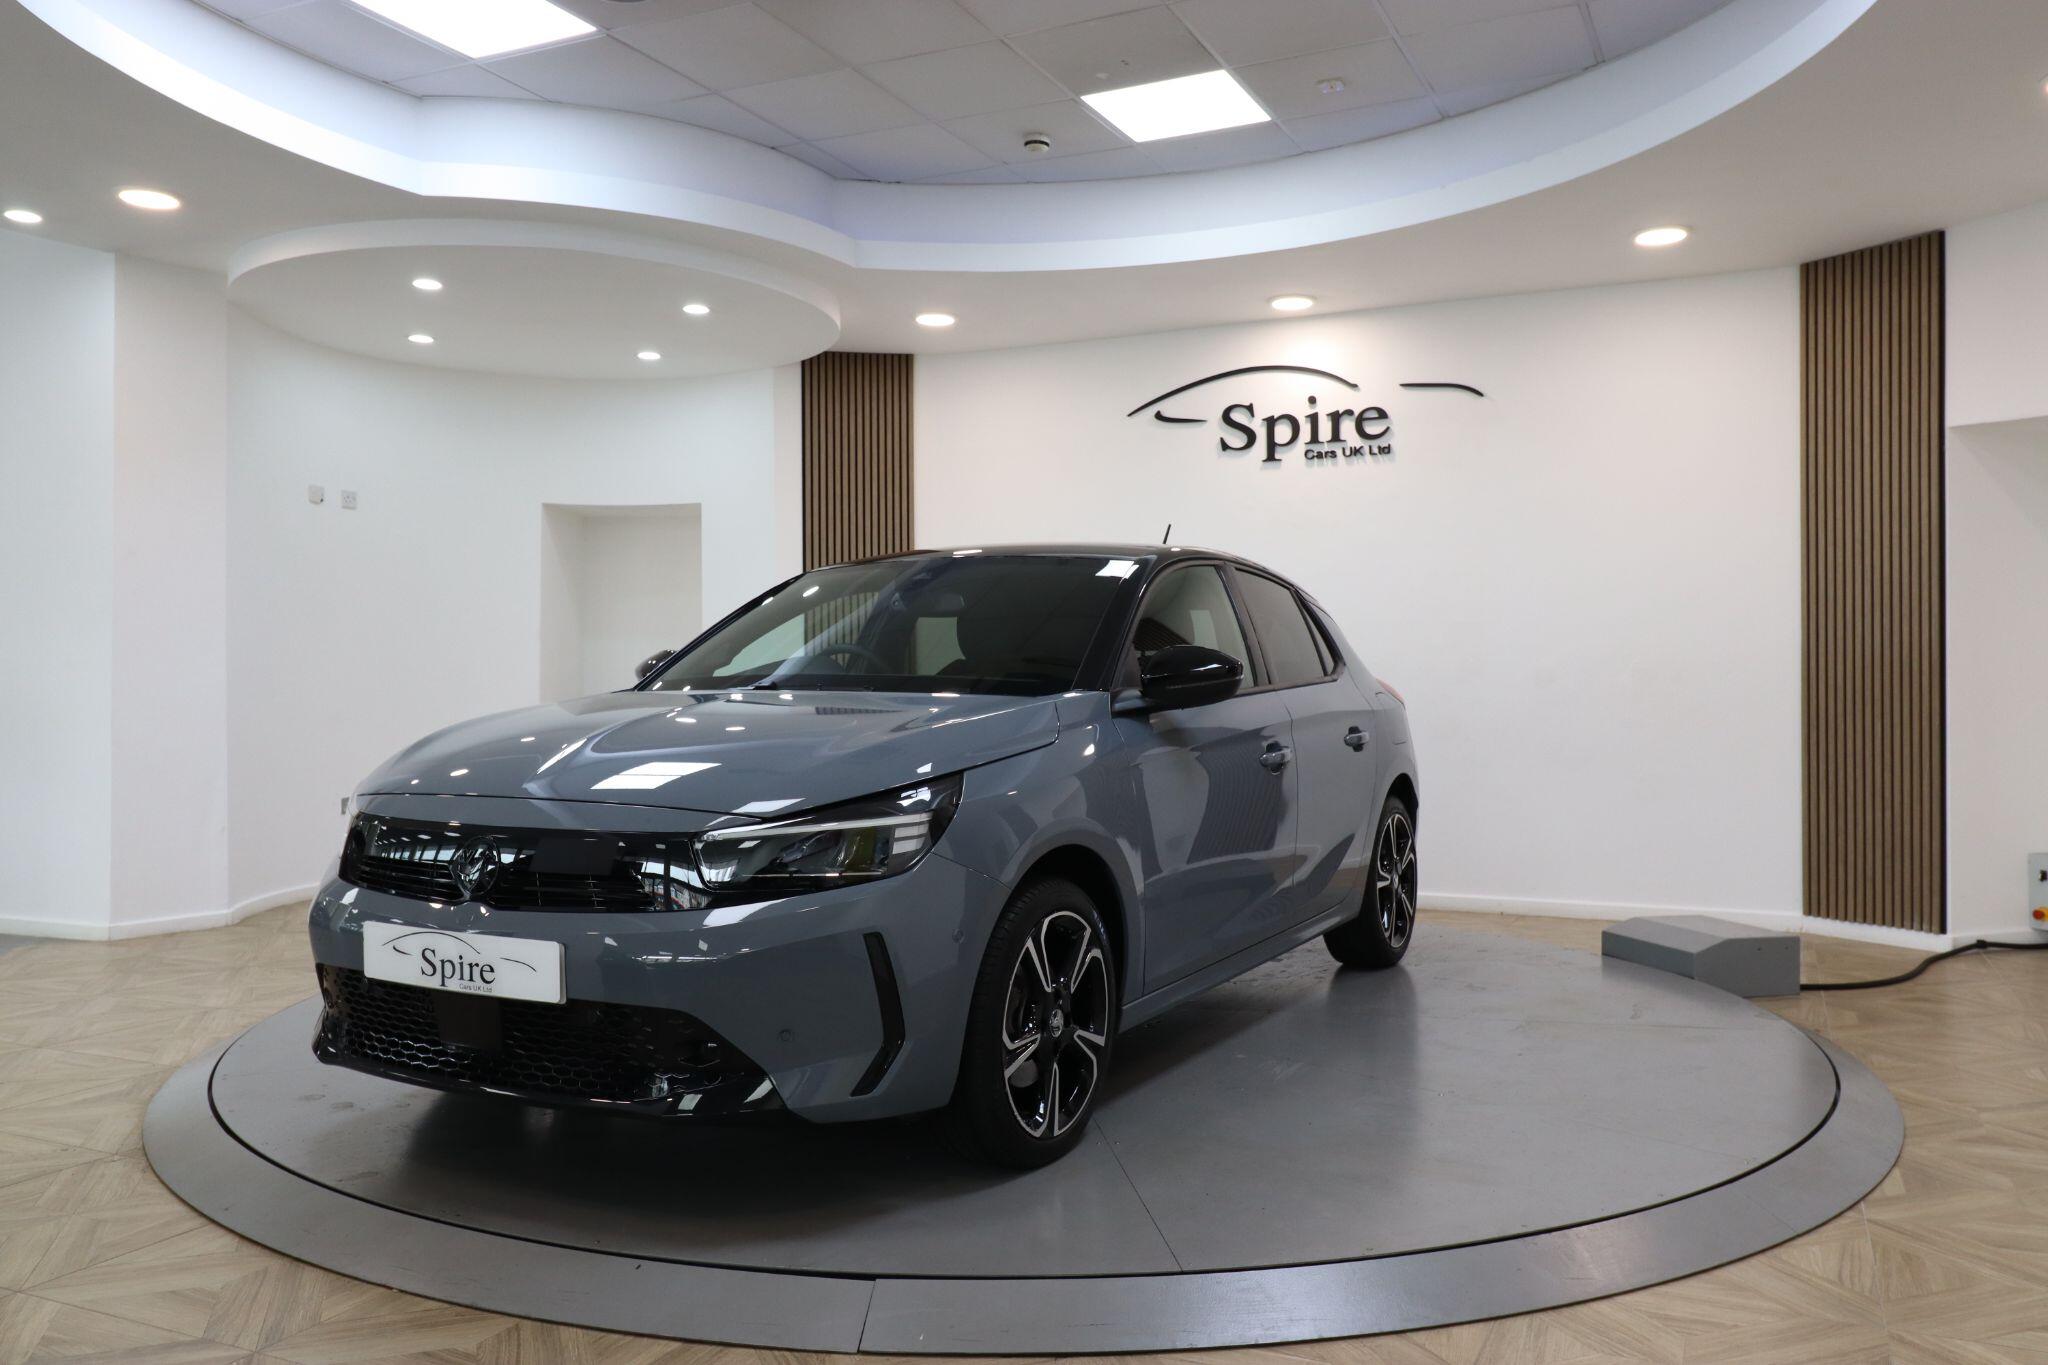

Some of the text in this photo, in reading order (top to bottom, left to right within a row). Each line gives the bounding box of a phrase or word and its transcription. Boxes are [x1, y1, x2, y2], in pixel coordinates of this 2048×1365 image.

[1219, 395, 1391, 463] Spire
[1304, 443, 1391, 461] Cars UK Ltd
[420, 947, 496, 988] Spire
